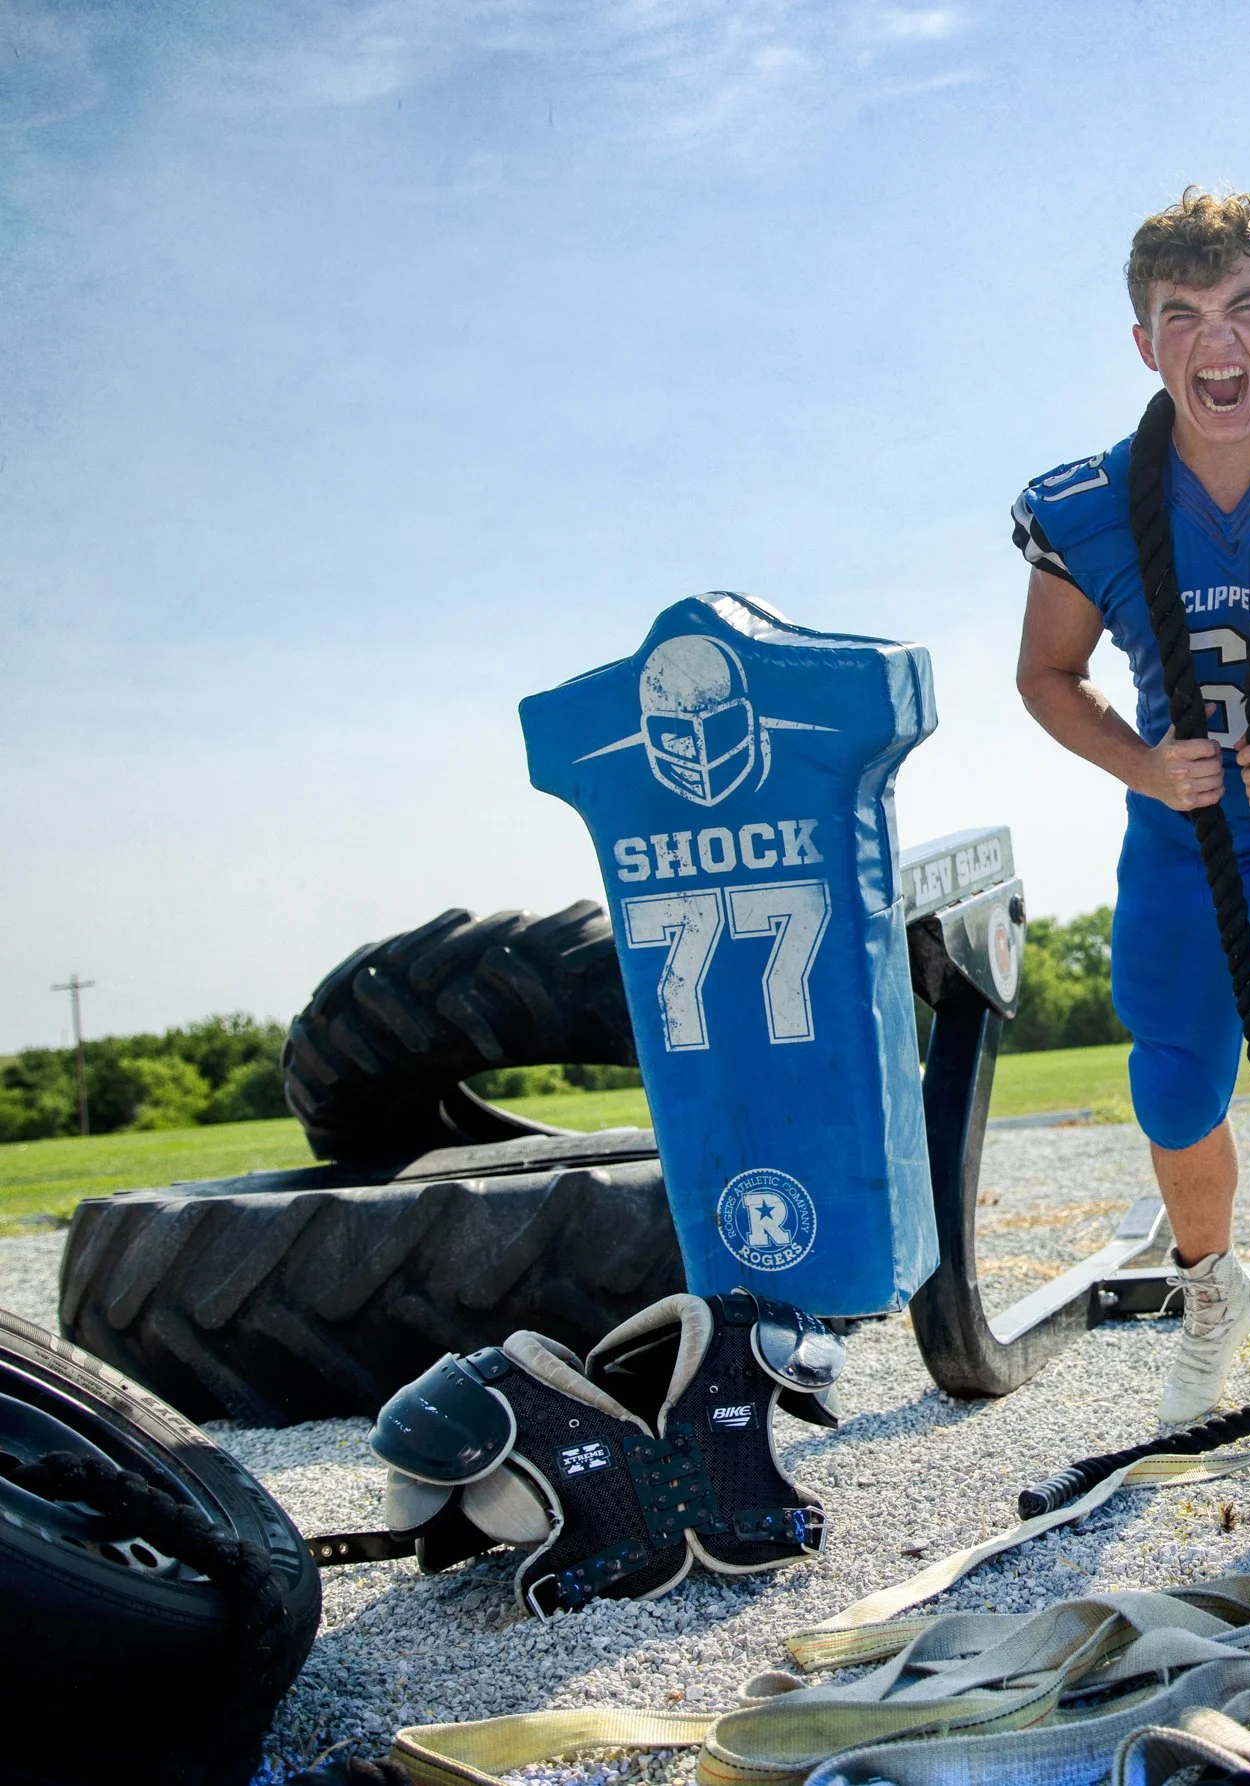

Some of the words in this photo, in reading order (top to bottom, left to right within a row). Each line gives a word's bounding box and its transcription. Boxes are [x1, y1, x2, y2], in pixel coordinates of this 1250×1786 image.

[613, 818, 824, 883] SHOCK
[955, 838, 1002, 888] SLED
[621, 877, 833, 1053] 77
[724, 1195, 737, 1239] ROGERS
[734, 1175, 780, 1198] ATHLETIC
[782, 1182, 810, 1234] COMPANY
[741, 1191, 792, 1248] R
[739, 1241, 803, 1266] ROGERS
[712, 1405, 752, 1419] BIKE
[563, 1449, 605, 1466] XTREME
